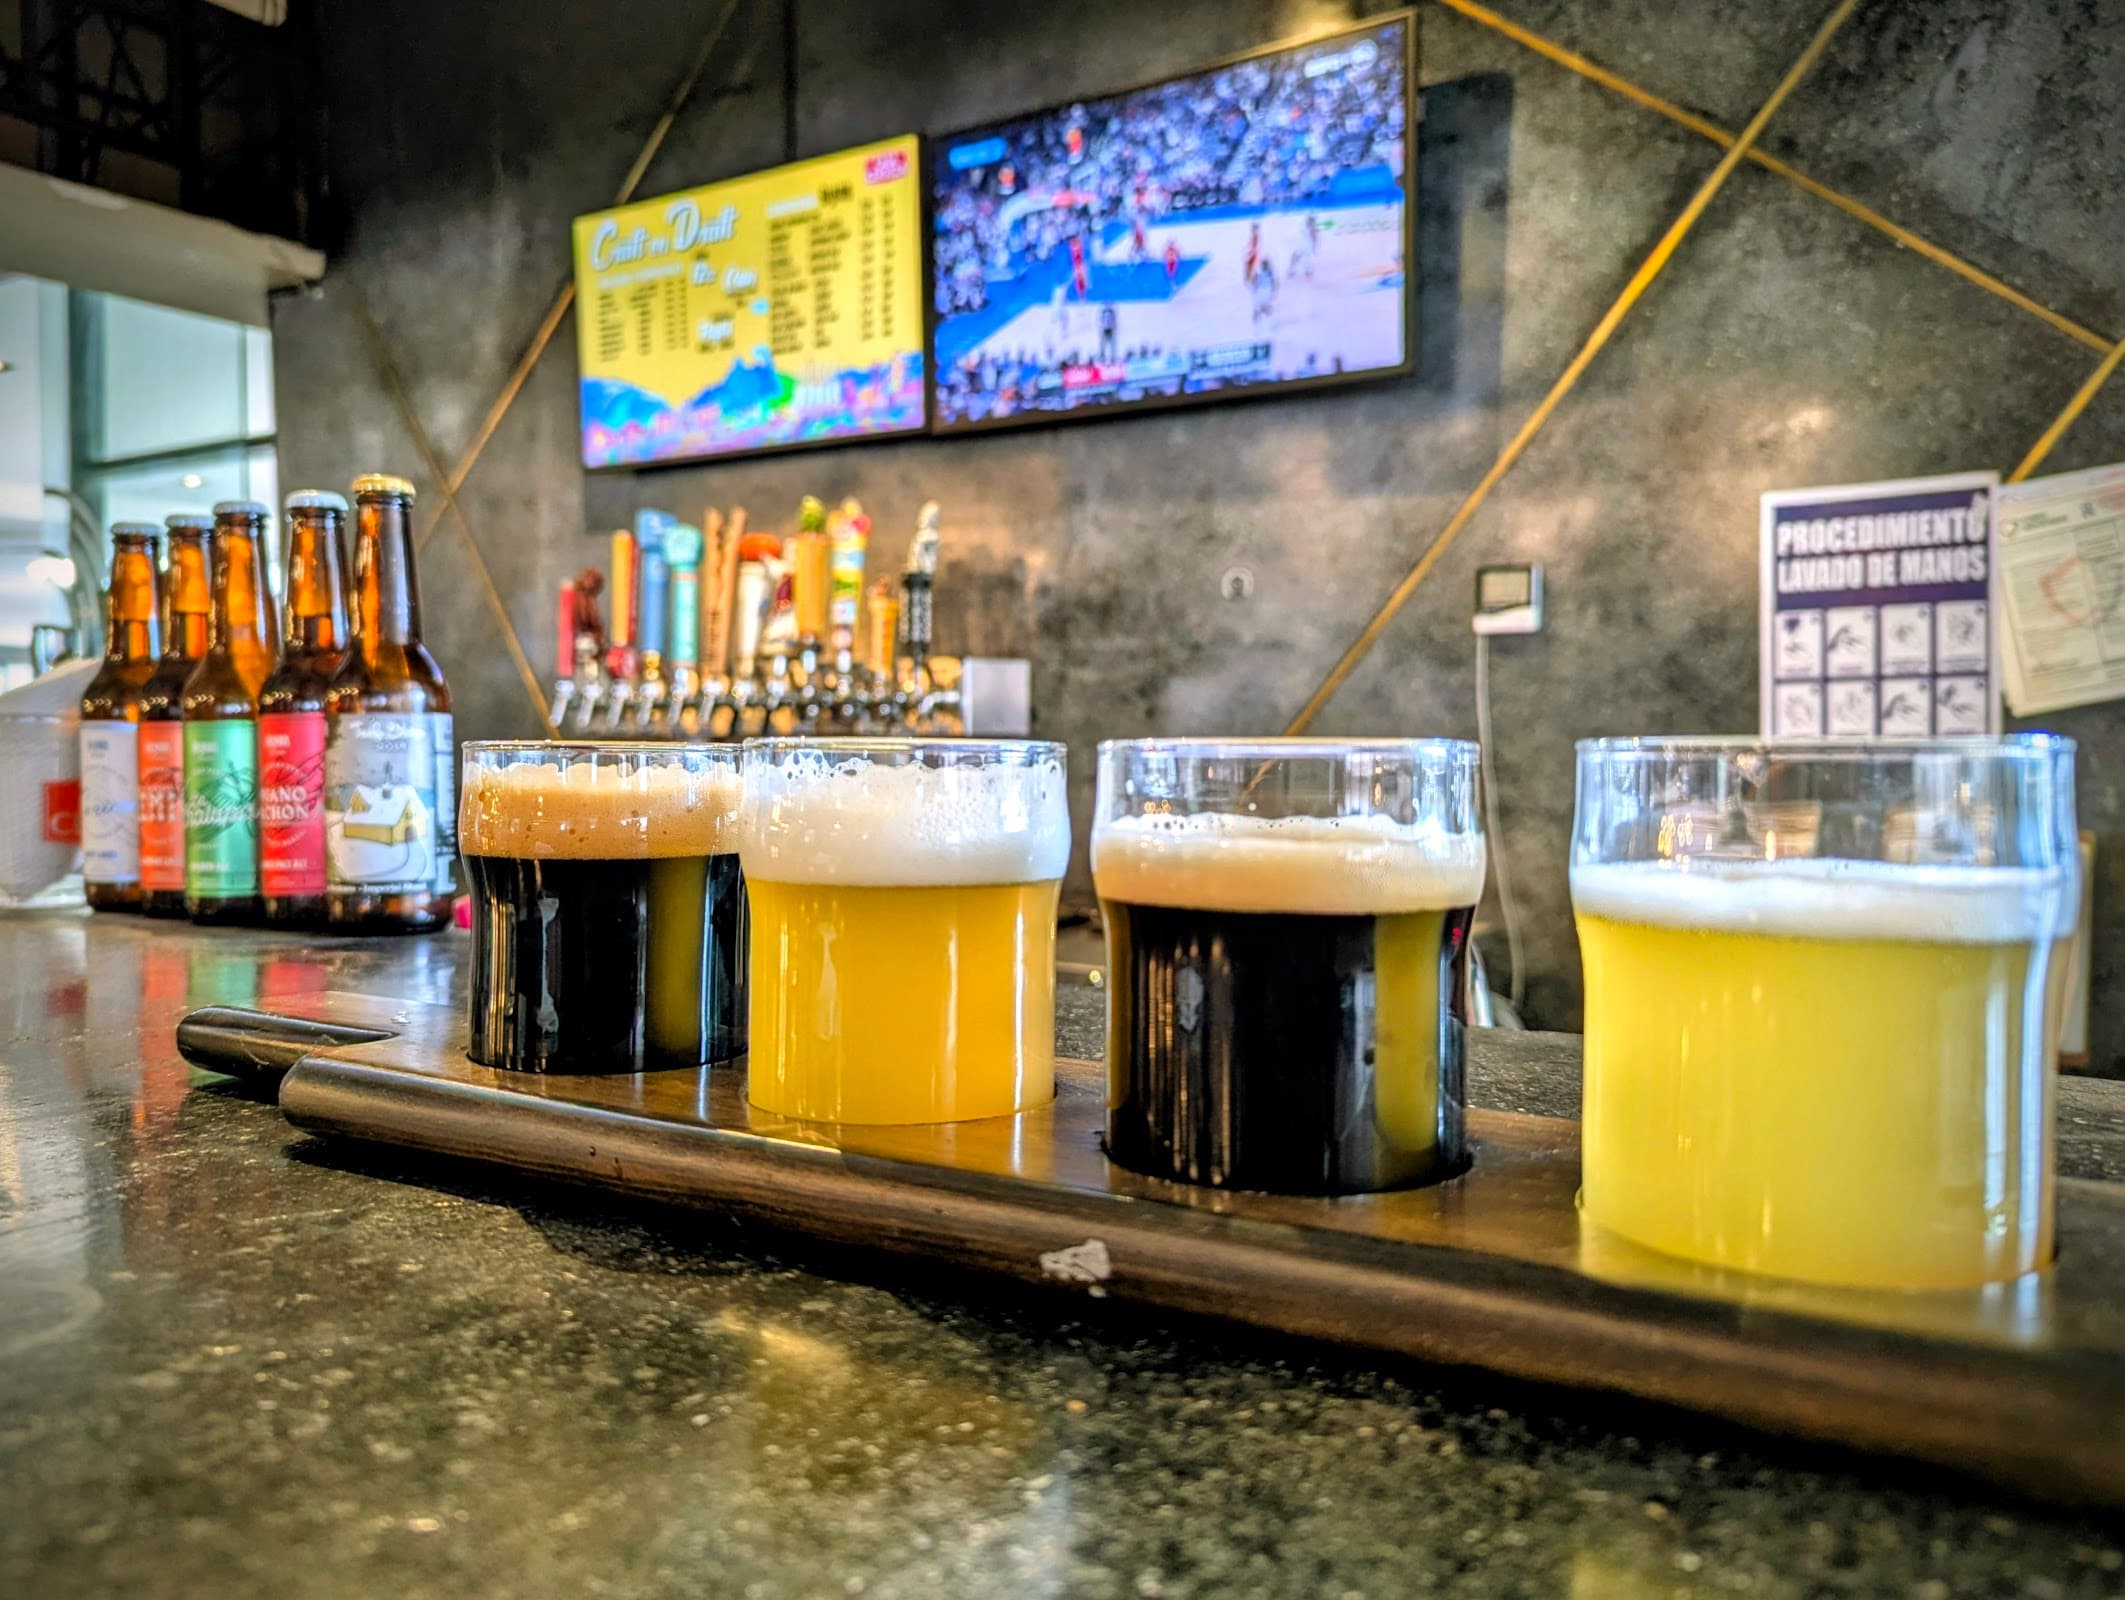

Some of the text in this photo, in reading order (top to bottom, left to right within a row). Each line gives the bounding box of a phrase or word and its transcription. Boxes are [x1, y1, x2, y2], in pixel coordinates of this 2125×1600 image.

[1777, 506, 1985, 557] PROCEDIMIENTO
[1778, 544, 1986, 594] LAVADO DE MANOS
